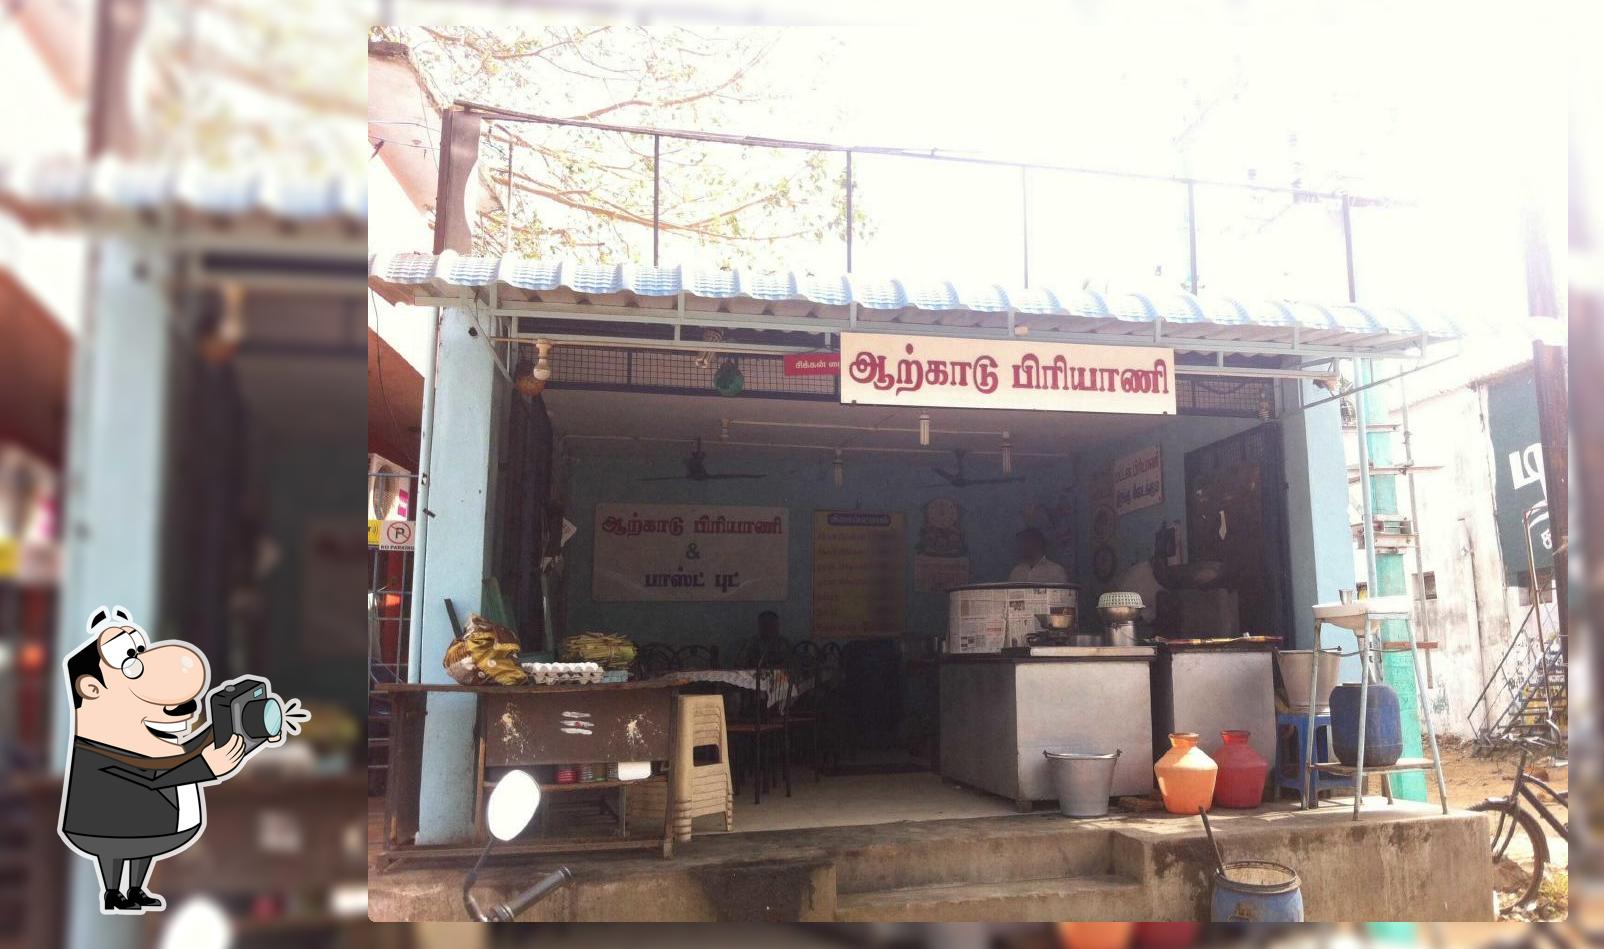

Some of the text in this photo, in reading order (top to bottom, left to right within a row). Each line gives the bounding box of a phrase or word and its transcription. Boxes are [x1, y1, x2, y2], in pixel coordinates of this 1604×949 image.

[849, 343, 1169, 396] ஆற்காடு பிரியாணி
[602, 512, 783, 539] ஆற்காடு பிரியாணி
[686, 542, 700, 560] &
[644, 566, 740, 592] பாஸ்ட் புட்
